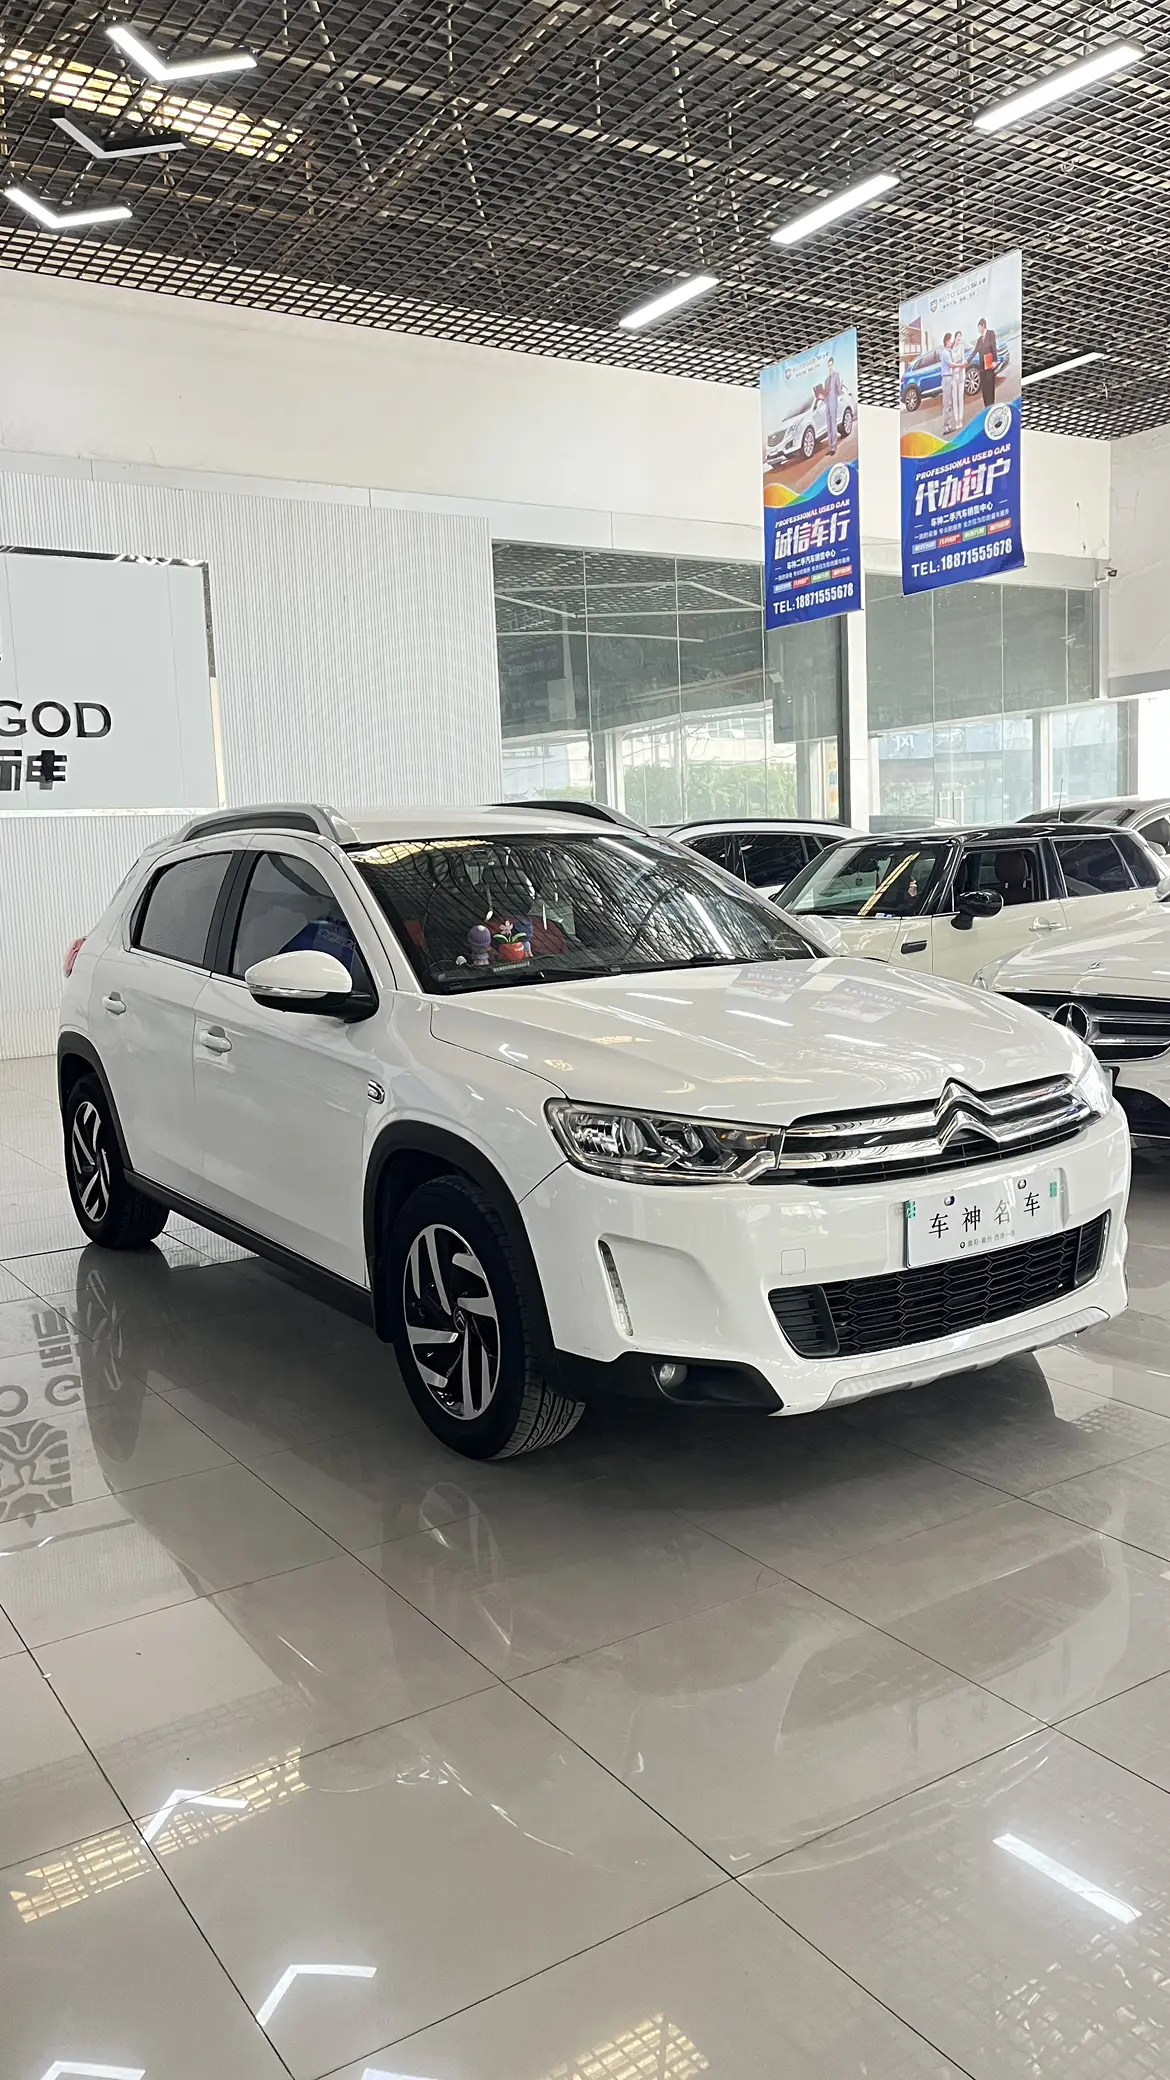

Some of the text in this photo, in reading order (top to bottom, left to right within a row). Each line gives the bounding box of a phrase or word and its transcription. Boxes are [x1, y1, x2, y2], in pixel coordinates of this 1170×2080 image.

[916, 443, 1011, 481] PROFESSIONAL USED CAR
[915, 457, 1011, 516] 代办过户
[775, 499, 850, 528] PROFESSIONAL USED CAR
[775, 509, 851, 560] 诚信车行
[911, 537, 1012, 577] TEL:18871555678
[773, 583, 854, 614] TEL:18871555678
[0, 700, 112, 738] GOD
[929, 1192, 1041, 1239] 车神名车
